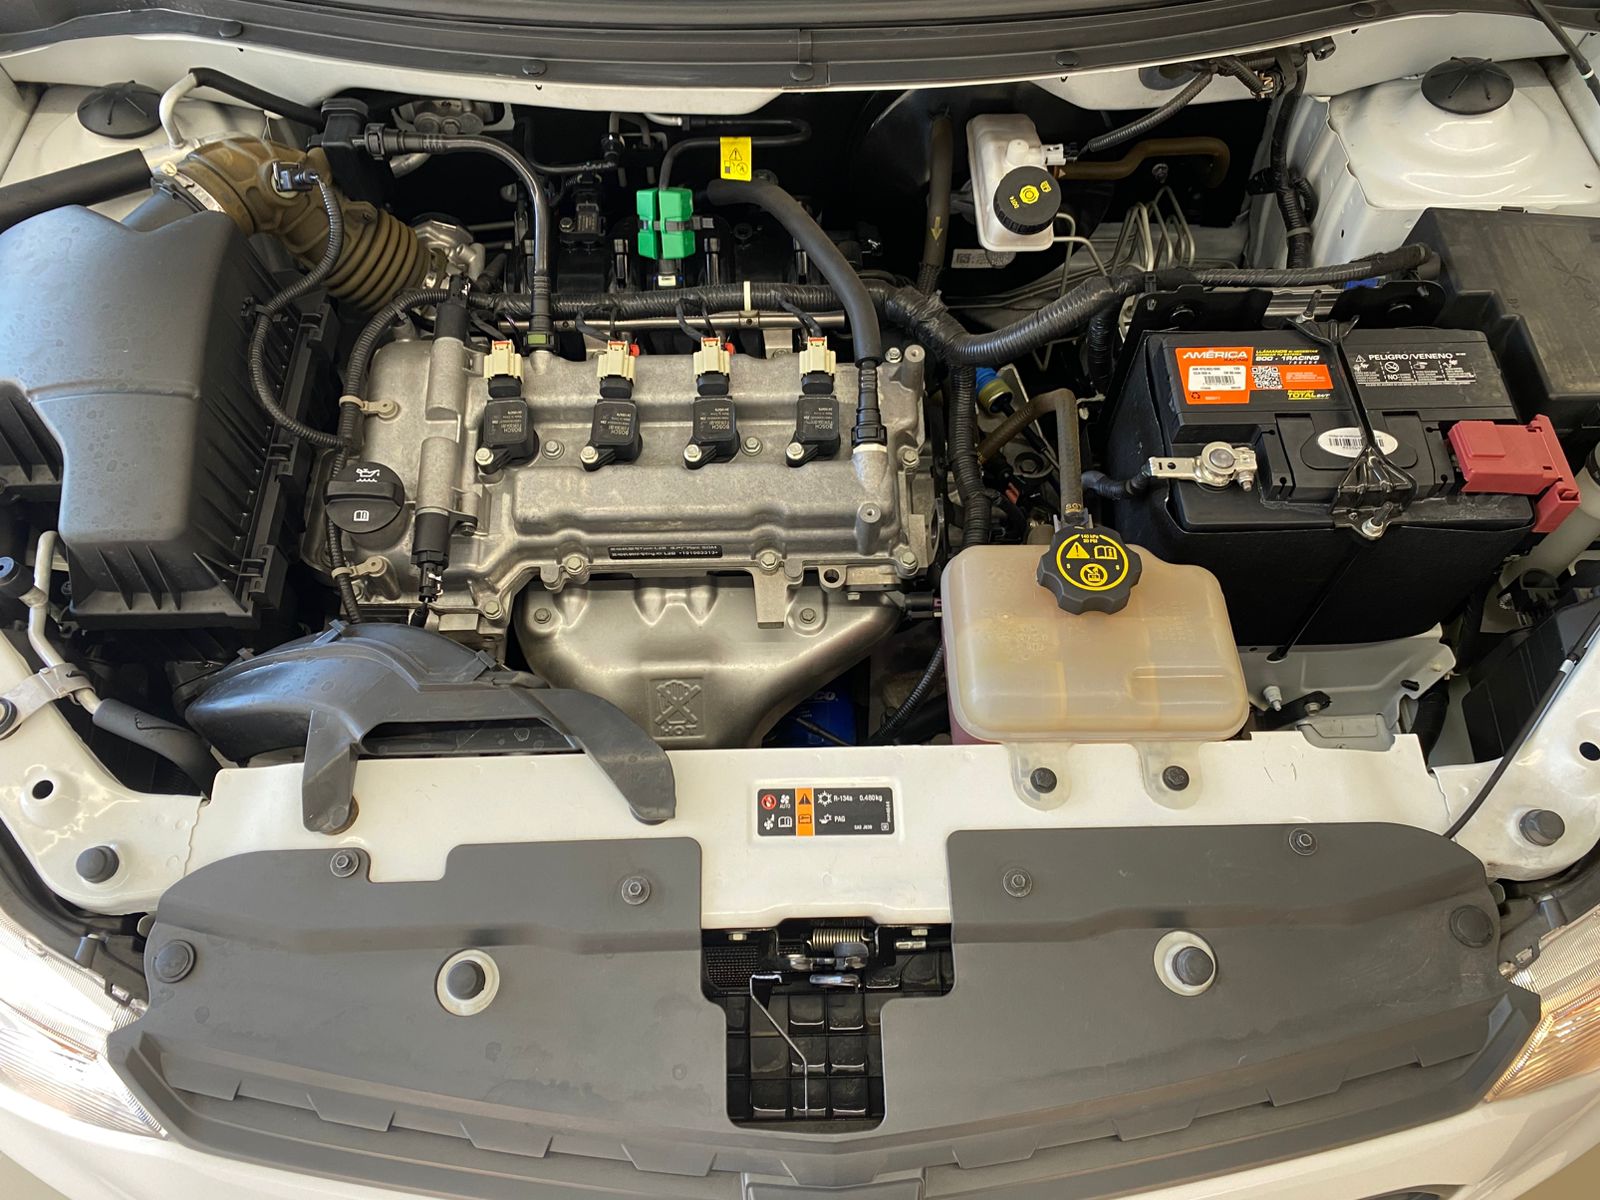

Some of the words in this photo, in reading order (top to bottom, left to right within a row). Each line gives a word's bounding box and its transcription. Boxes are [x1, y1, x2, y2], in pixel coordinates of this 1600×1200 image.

[1183, 350, 1248, 359] AMÉRICA
[1368, 353, 1453, 361] PELIGRO/VENENO
[660, 724, 697, 736] HOT
[833, 794, 853, 802] R-134a
[834, 815, 846, 823] PAG
